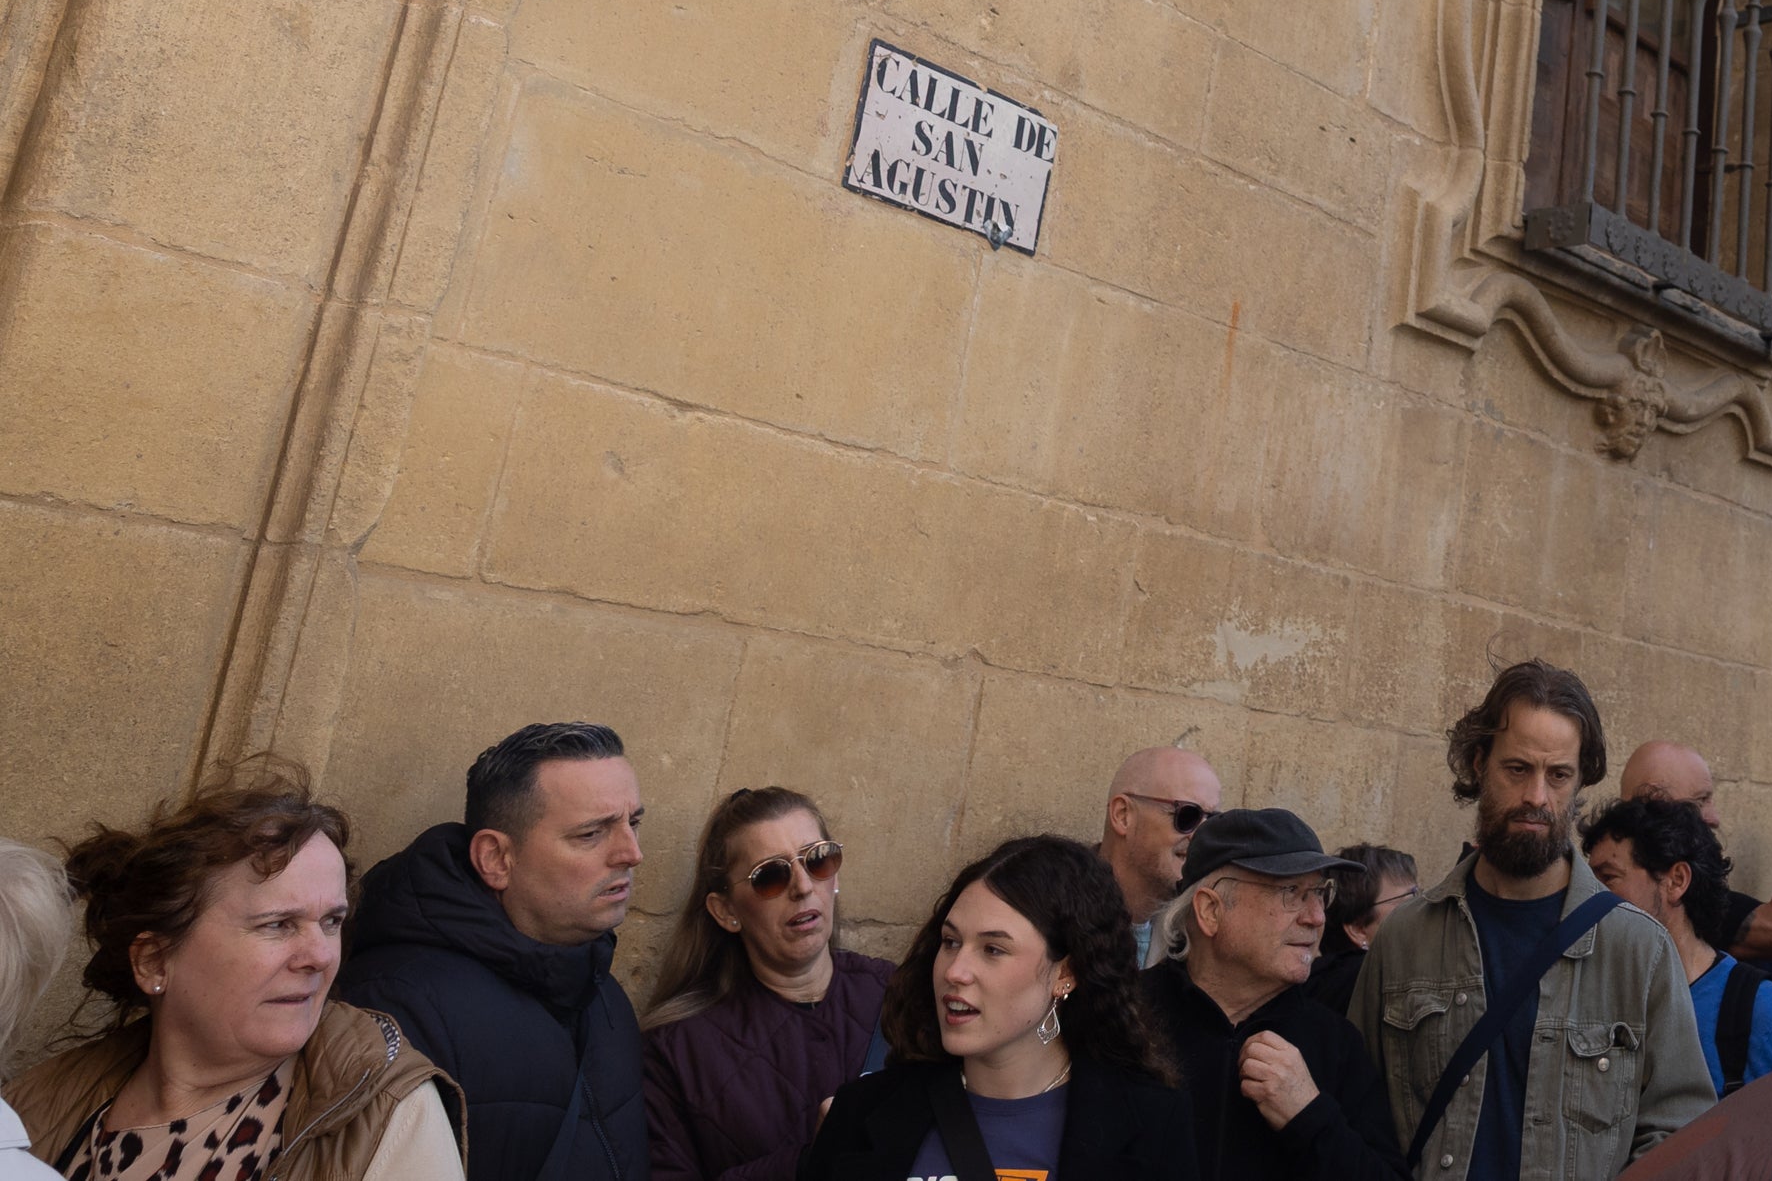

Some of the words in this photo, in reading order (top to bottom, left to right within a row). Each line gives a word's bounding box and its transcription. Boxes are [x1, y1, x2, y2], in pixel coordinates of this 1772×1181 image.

[876, 56, 995, 139] CALLE
[1012, 114, 1058, 164] DE
[911, 120, 985, 177] SAN
